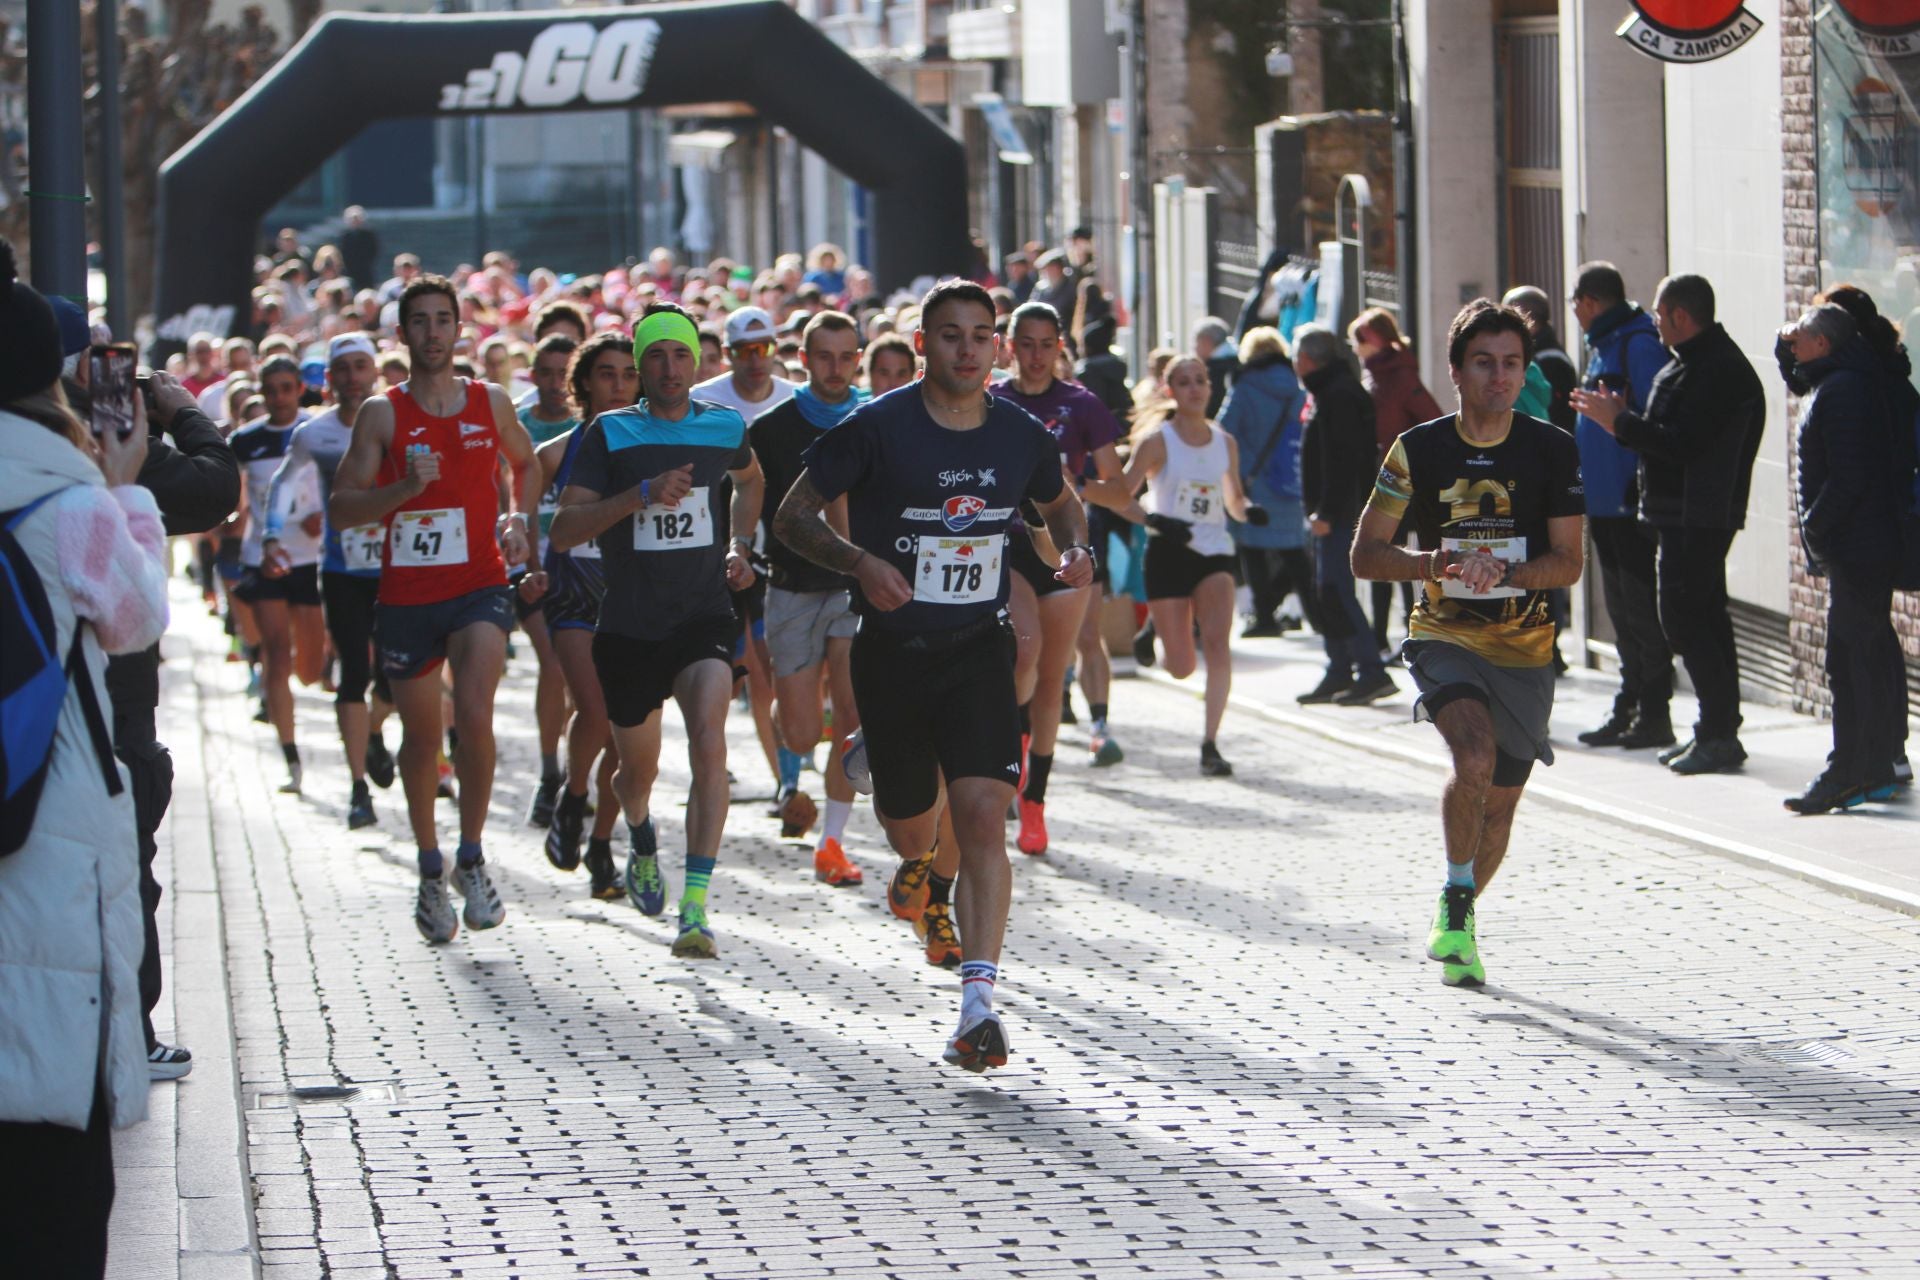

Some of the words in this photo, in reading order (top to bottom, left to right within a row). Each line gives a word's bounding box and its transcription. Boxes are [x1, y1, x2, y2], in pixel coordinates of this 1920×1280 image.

[1673, 21, 1753, 57] ZAMPOLA
[938, 469, 974, 487] gijón
[653, 512, 694, 541] 182
[912, 511, 939, 519] GIJÓN
[1458, 521, 1515, 529] ANIVERSARIO
[413, 531, 442, 556] 47
[941, 563, 982, 593] 178
